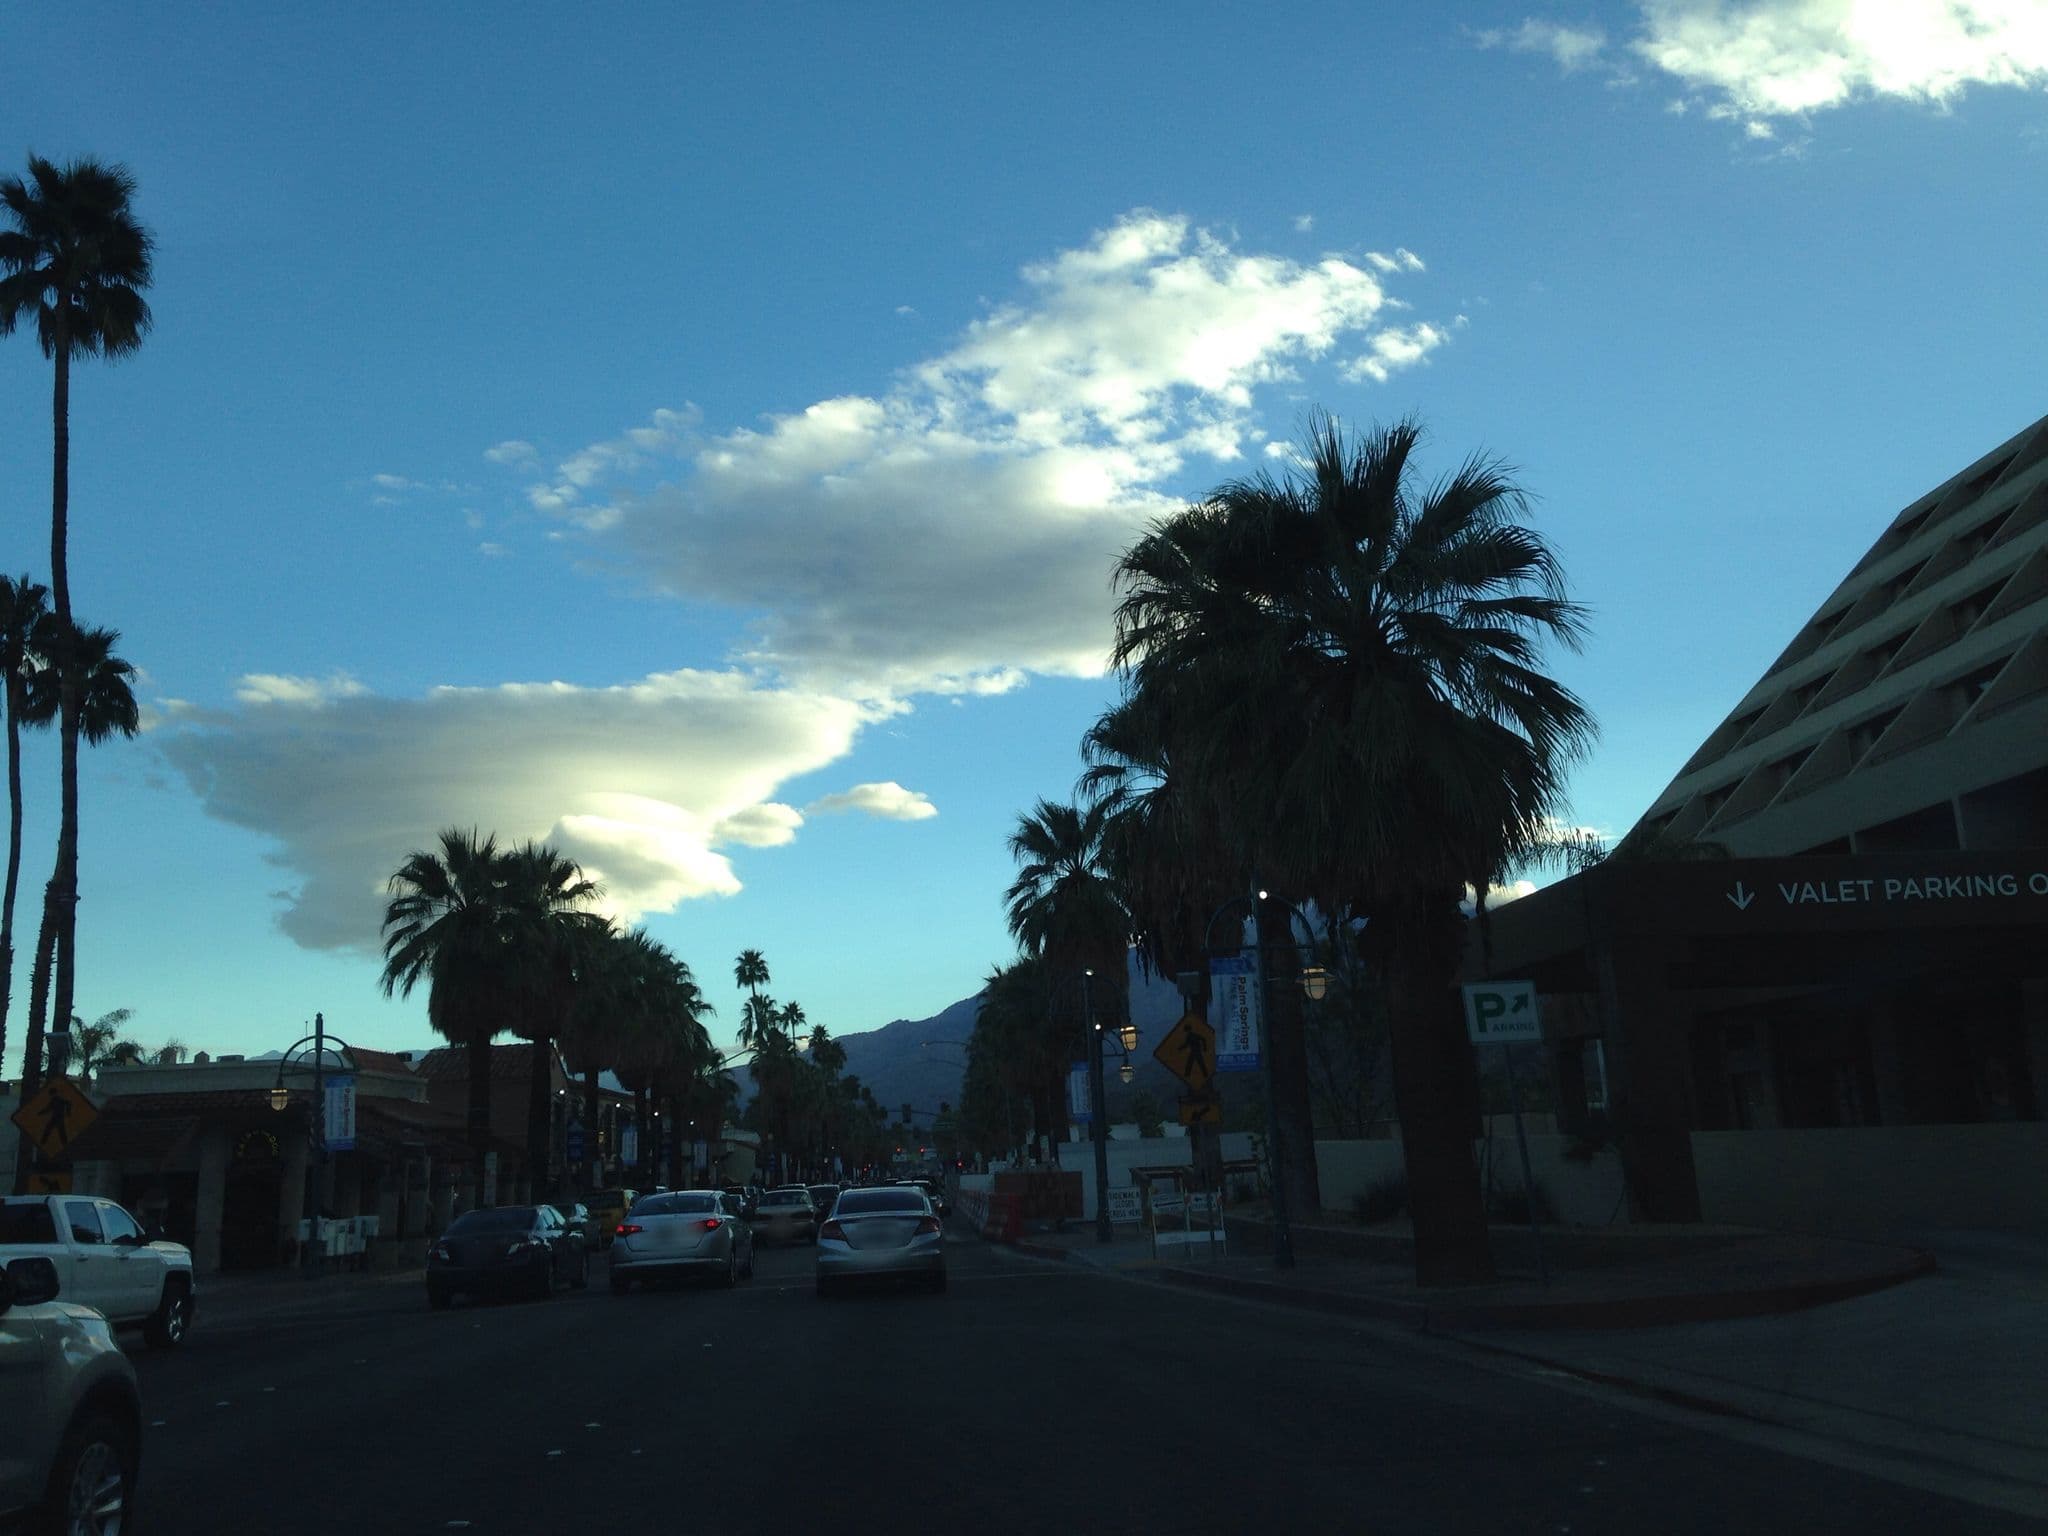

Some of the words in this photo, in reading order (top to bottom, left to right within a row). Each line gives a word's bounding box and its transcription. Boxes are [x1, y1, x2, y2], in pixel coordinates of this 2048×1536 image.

[1778, 880, 1873, 904] VALET
[1884, 874, 2018, 901] PARKING
[1238, 976, 1247, 1005] Palm
[1239, 1006, 1250, 1051] Springs
